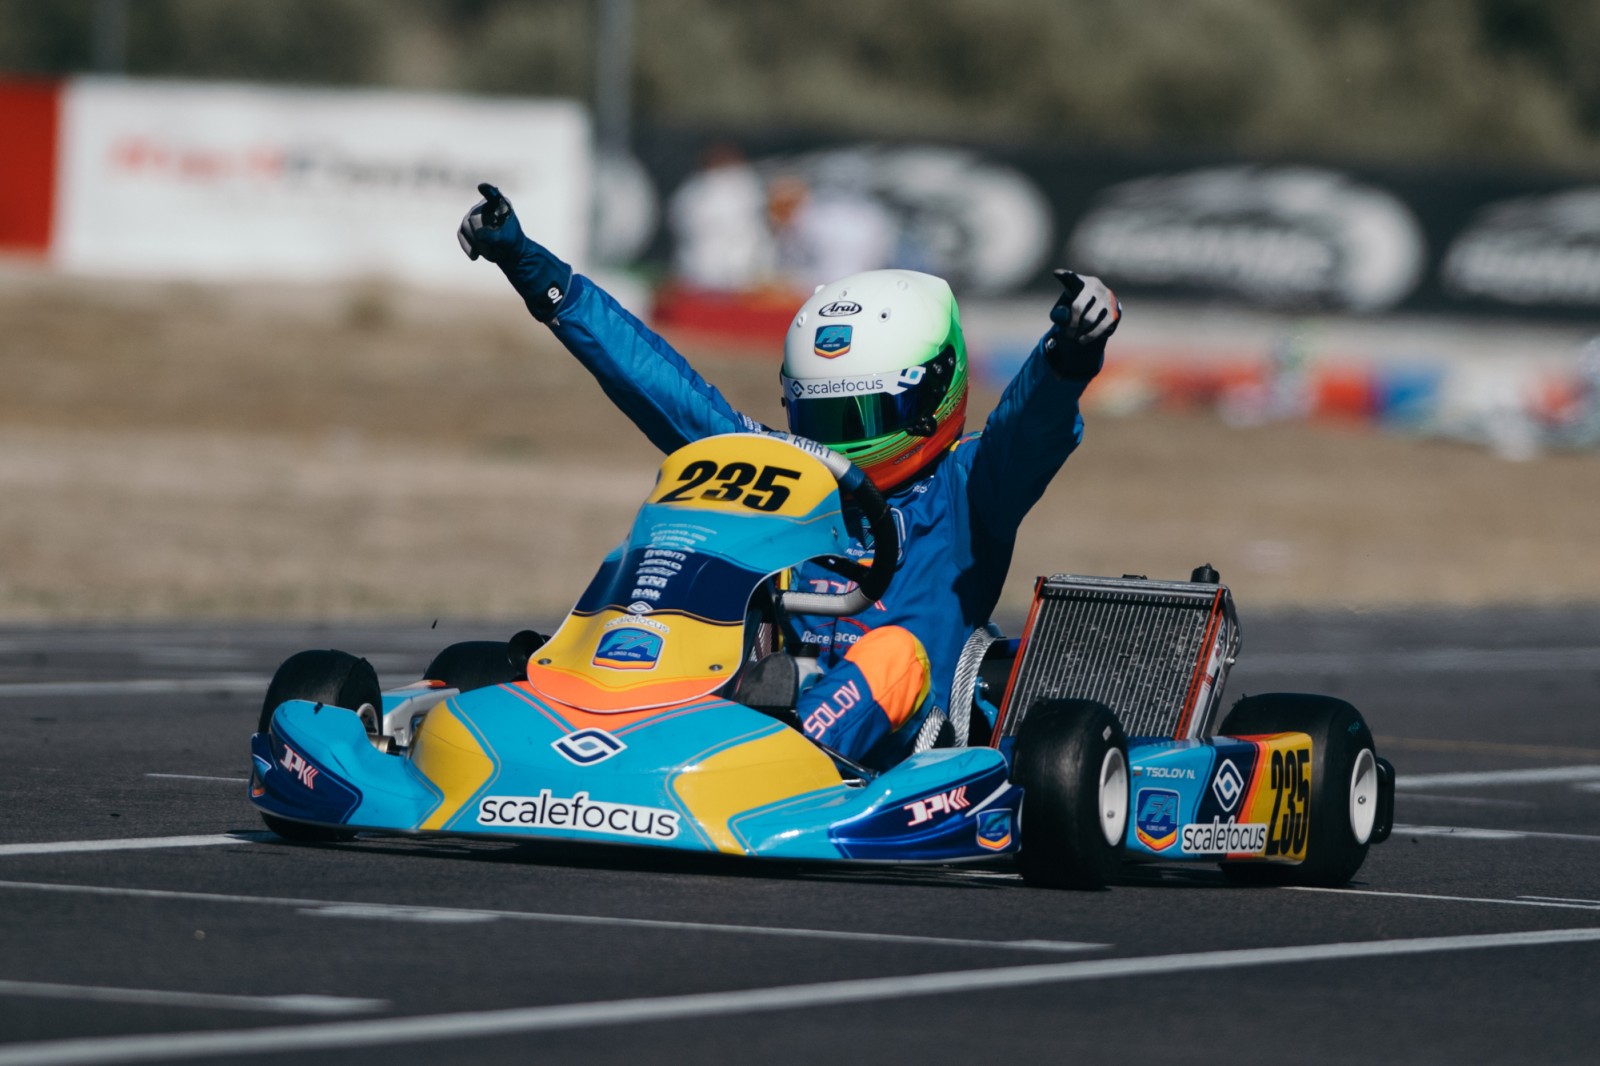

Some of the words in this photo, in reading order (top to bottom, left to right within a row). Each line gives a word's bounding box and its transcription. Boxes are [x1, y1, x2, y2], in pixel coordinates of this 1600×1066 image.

[822, 302, 857, 313] Arai
[807, 378, 884, 395] scalefocus
[656, 460, 802, 512] 235
[1146, 767, 1185, 779] TSOLOV
[480, 793, 675, 837] scalefocus
[1266, 749, 1310, 856] 235
[1183, 817, 1266, 851] scalefocus
